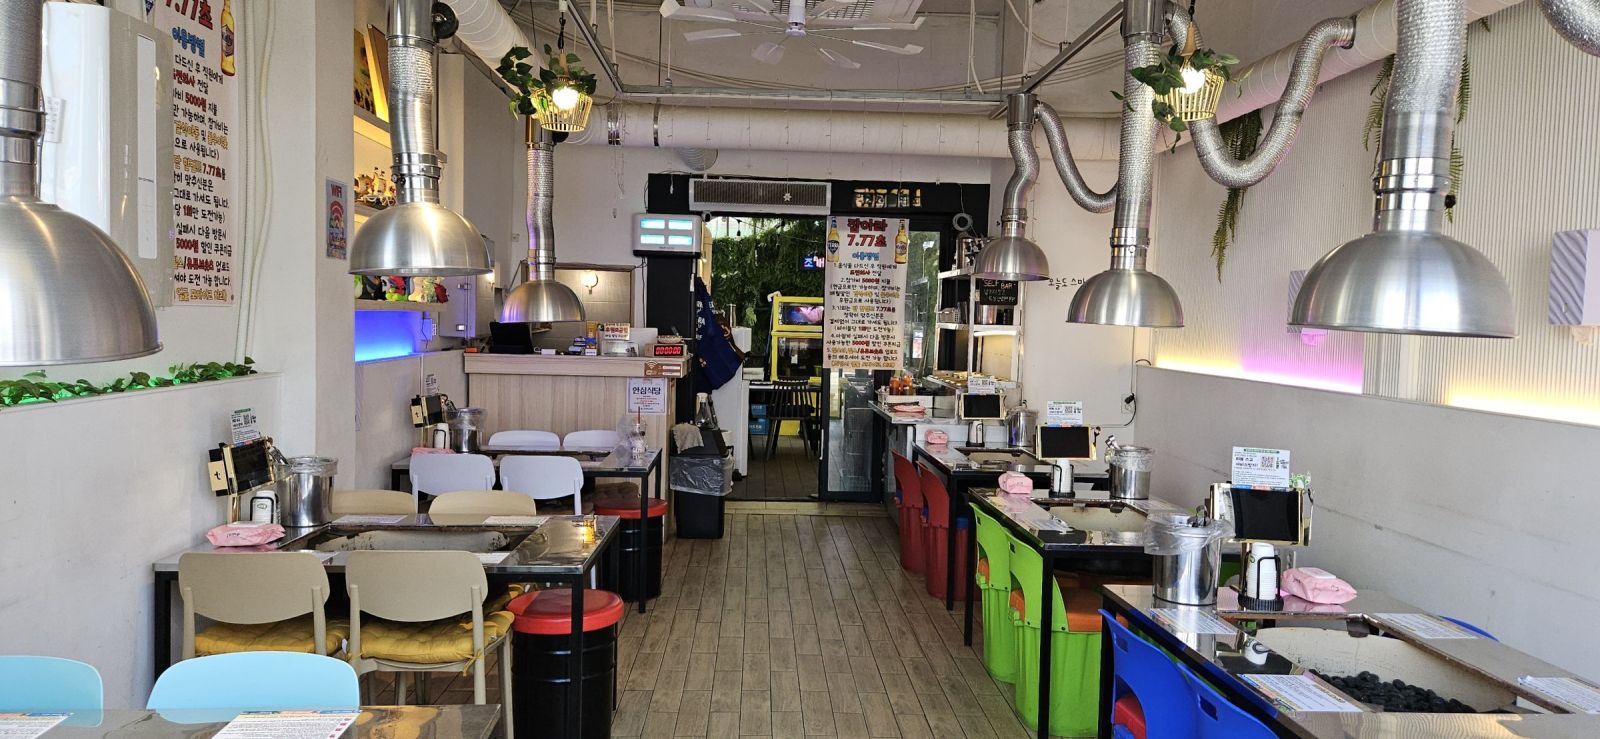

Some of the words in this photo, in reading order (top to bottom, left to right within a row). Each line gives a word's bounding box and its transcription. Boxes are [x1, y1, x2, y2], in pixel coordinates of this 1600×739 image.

[172, 26, 205, 58] 이용방법
[195, 63, 200, 74] 후
[203, 66, 223, 84] 직원에게
[197, 79, 208, 95] 전달
[185, 92, 206, 112] 5000원
[208, 102, 217, 116] 지불
[208, 117, 228, 135] 참가비는
[201, 130, 206, 142] 및
[189, 142, 219, 160] 사용됩니다)
[185, 174, 213, 192] 맞추신분은
[174, 188, 191, 200] 그대로
[193, 192, 211, 204] 가셔도
[176, 222, 195, 235] 실패시
[198, 226, 210, 239] 다음
[212, 228, 226, 240] 방문시
[847, 218, 888, 233] 잡아라
[176, 238, 198, 254] 5000원
[200, 241, 212, 254] 할인
[214, 243, 232, 257] 쿠폰지급
[847, 234, 887, 247] 7.77초
[852, 251, 880, 261] 이용방법
[216, 261, 229, 272] 업로드
[188, 274, 200, 286] 도전
[202, 274, 212, 287] 가능
[1048, 278, 1067, 290] 오늘도
[632, 386, 661, 395] 안심식당
